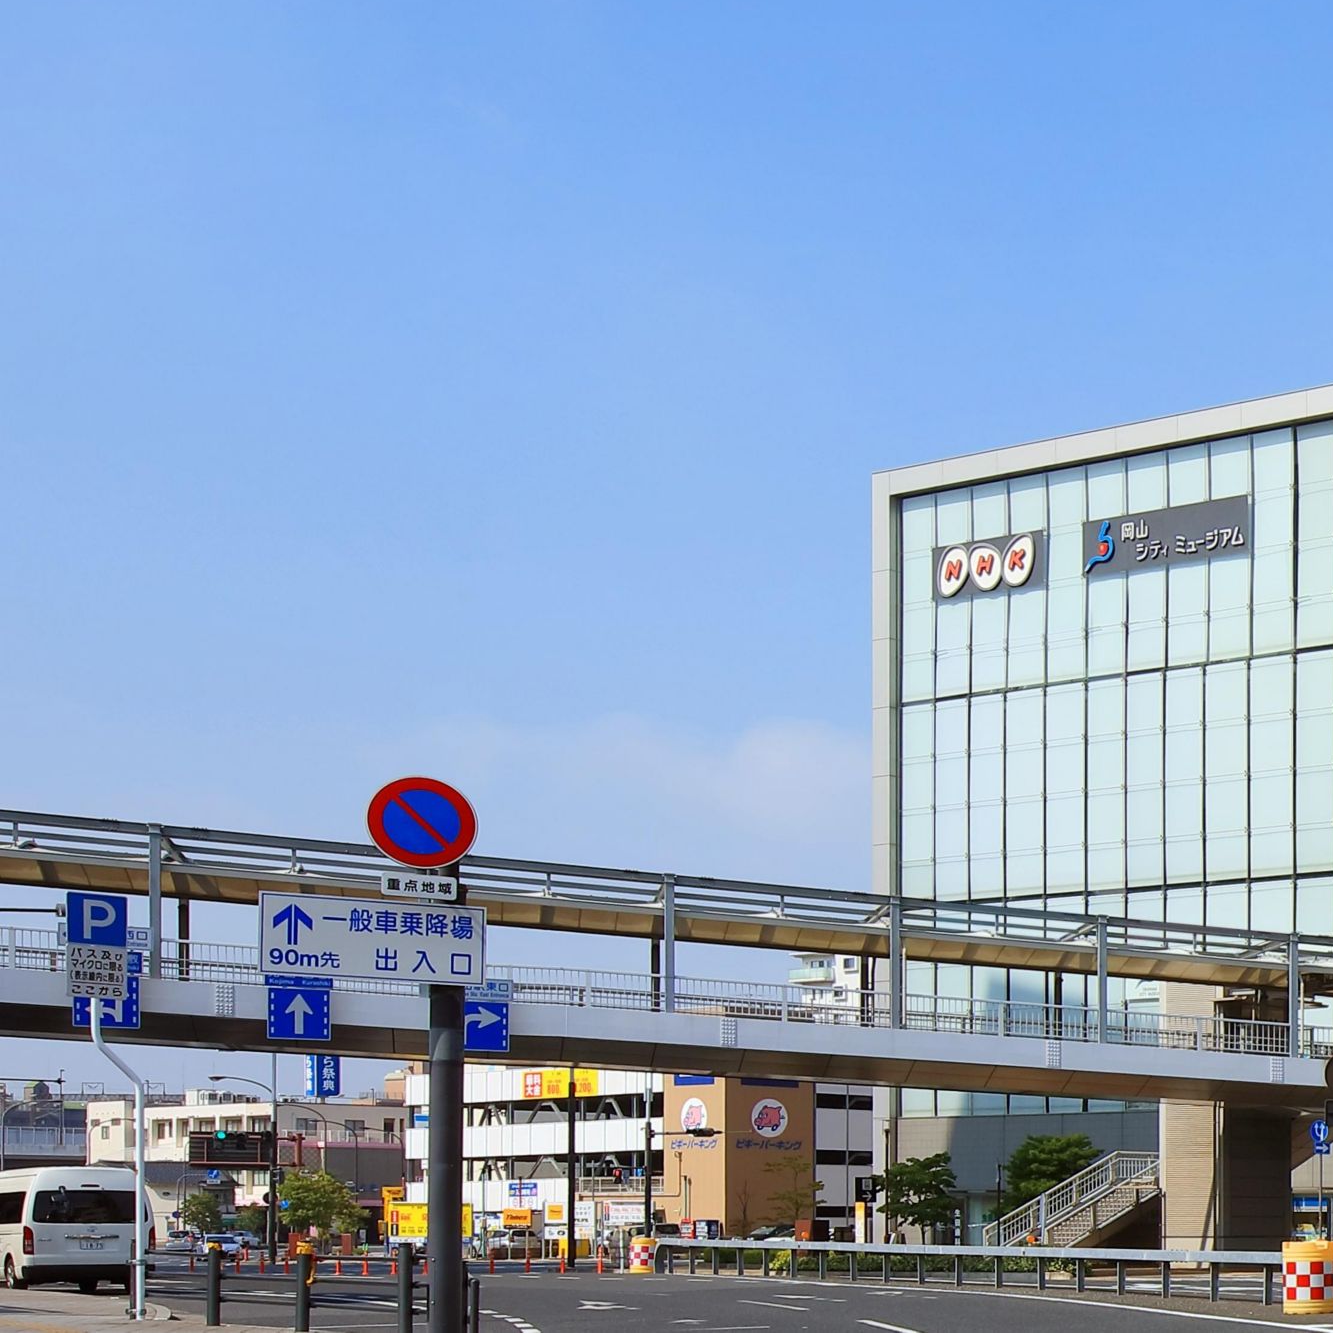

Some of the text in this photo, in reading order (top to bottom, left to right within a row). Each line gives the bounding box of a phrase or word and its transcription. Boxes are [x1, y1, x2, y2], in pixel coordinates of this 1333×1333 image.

[1121, 519, 1149, 542] 岡山
[1175, 526, 1244, 554] ミュージアム
[386, 878, 452, 895] 重点地域
[83, 898, 117, 940] P
[321, 908, 474, 940] 一般車乗降場
[70, 947, 123, 962] バス及び
[269, 947, 472, 976] 90m先 出入口
[71, 984, 123, 997] ここから
